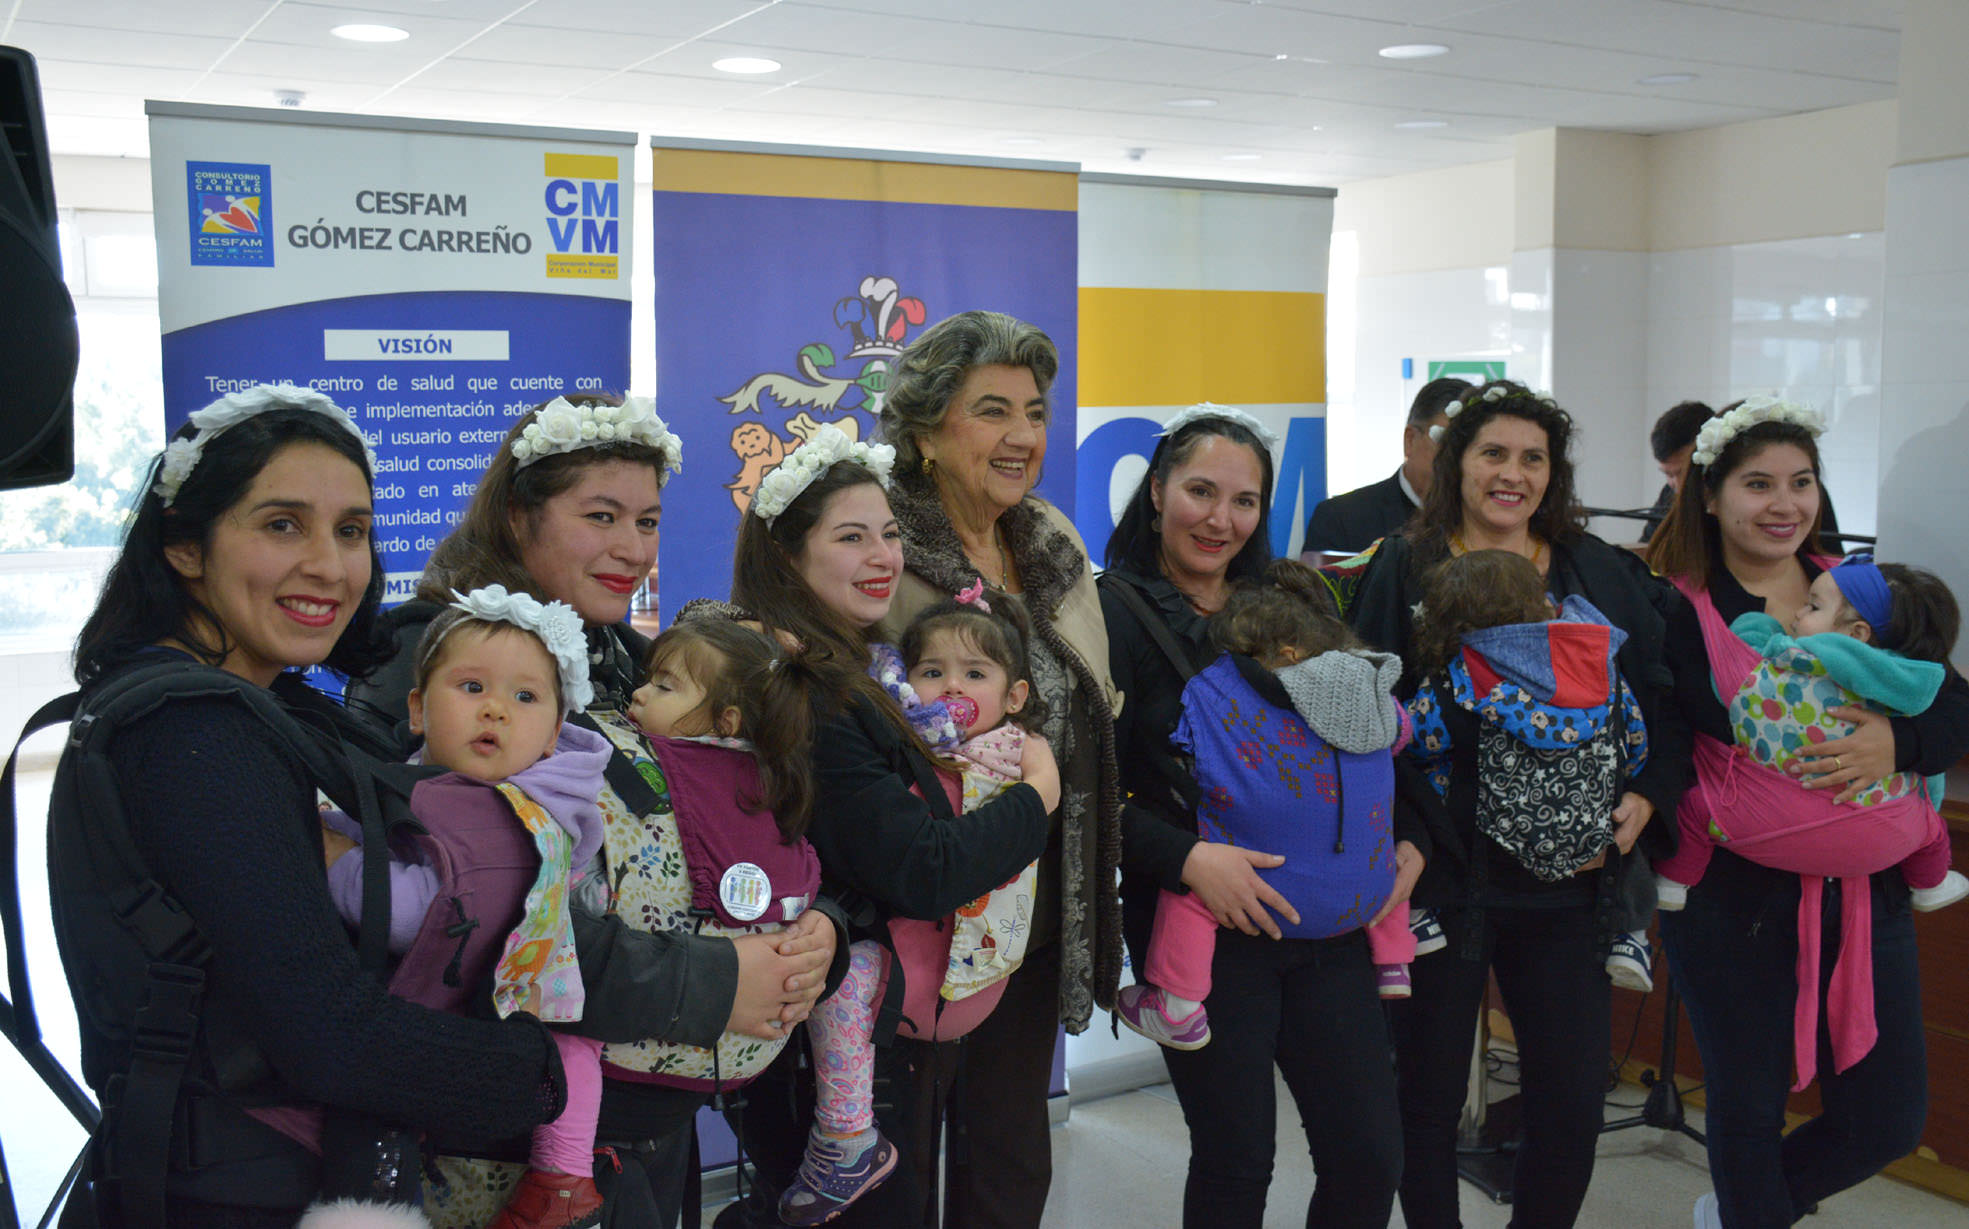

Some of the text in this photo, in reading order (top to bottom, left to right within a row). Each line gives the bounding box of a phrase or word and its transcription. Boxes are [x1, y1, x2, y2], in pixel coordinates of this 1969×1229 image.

[356, 190, 467, 217] CESFAM
[545, 179, 618, 218] CM
[198, 237, 263, 247] CESFAM
[288, 218, 532, 255] GÓMEZ CARREÑO
[546, 217, 618, 254] VM
[378, 334, 452, 354] VISIÓN
[205, 376, 258, 393] Tener
[309, 377, 363, 391] centro
[377, 375, 398, 391] de
[411, 375, 454, 390] salud
[467, 377, 498, 394] que
[510, 376, 564, 390] cuente
[576, 377, 602, 389] con
[366, 400, 495, 421] implementación
[391, 429, 452, 445] usuario
[377, 453, 496, 473] salud consolid
[372, 482, 405, 499] ado
[418, 485, 439, 498] en
[415, 535, 435, 551] de
